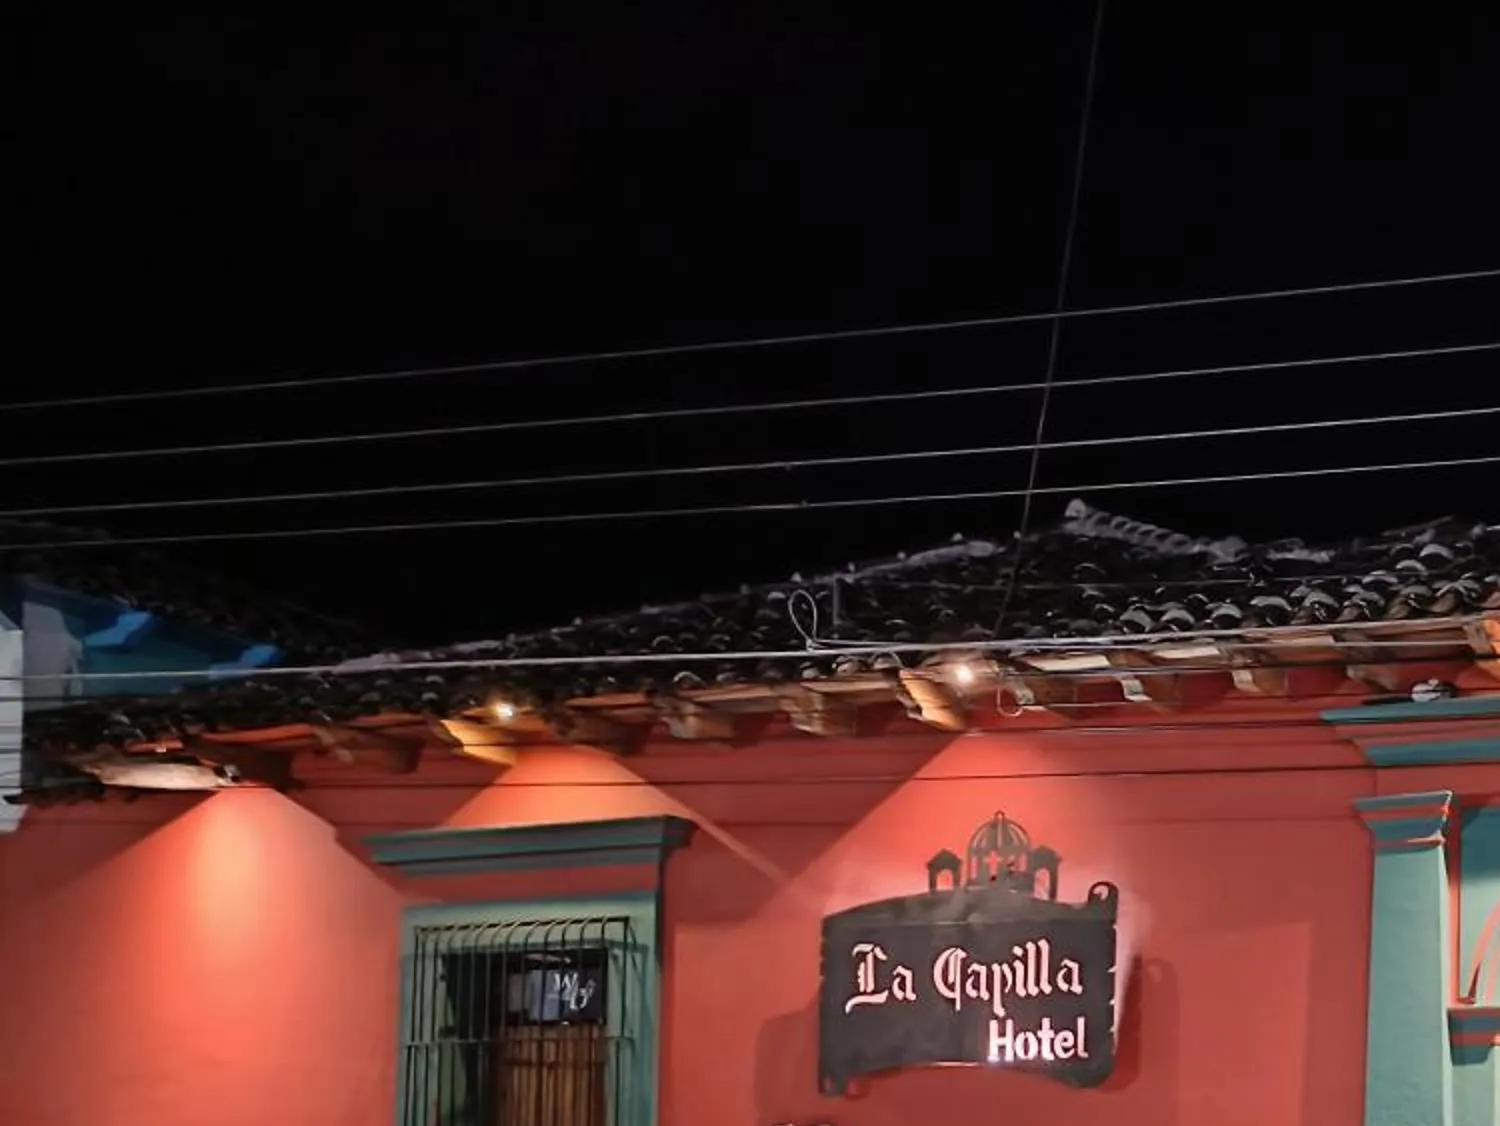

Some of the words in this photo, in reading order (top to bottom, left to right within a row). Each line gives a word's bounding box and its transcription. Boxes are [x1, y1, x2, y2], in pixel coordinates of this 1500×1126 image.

[845, 943, 917, 1014] La
[932, 938, 1084, 1017] Capilla
[987, 1016, 1089, 1063] Hotel
